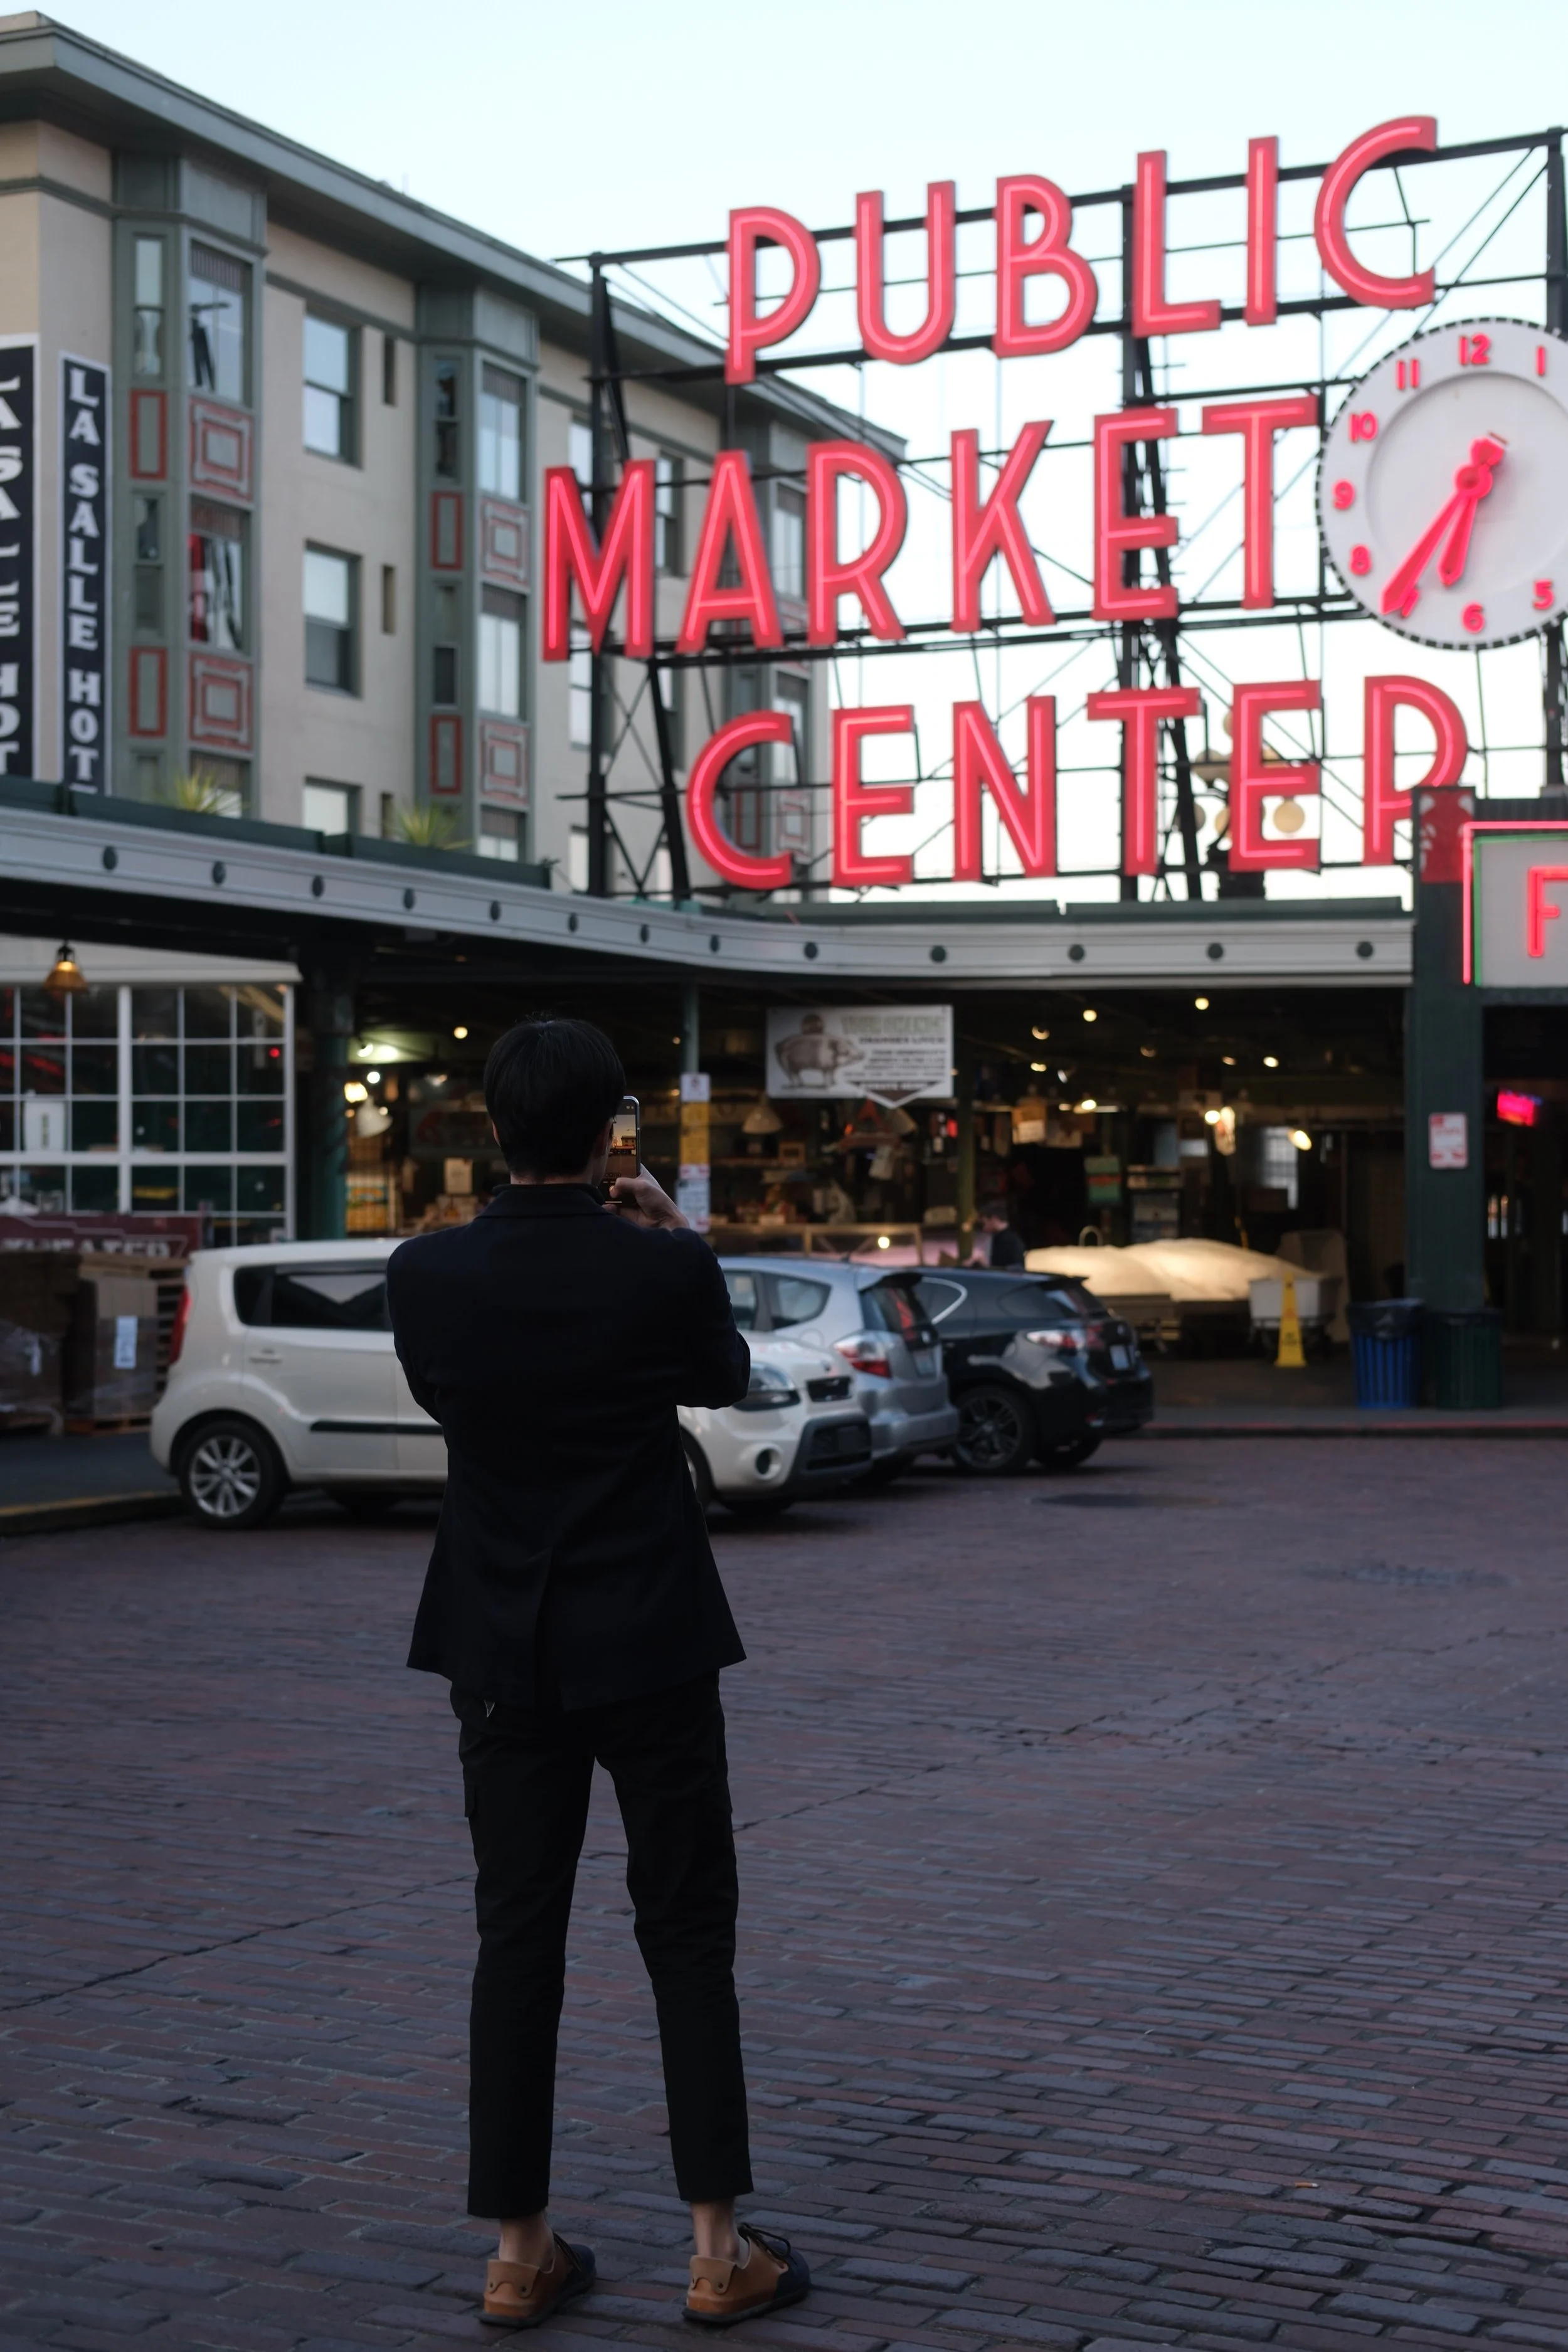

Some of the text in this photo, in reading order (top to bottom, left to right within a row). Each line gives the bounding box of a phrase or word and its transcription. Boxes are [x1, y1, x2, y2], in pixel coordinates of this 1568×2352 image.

[725, 115, 1438, 385] PUBLIC
[1458, 333, 1491, 366] 12
[1536, 346, 1546, 376] 1
[1396, 358, 1420, 390] 11
[1348, 411, 1378, 443] 10
[1332, 479, 1355, 511] 9
[542, 394, 1318, 661] MARKET
[1349, 543, 1372, 576] 8
[67, 366, 102, 794] LA SALLE HOT
[1533, 579, 1554, 610] 5
[1461, 601, 1485, 634] 6
[687, 674, 1468, 889] CENTER
